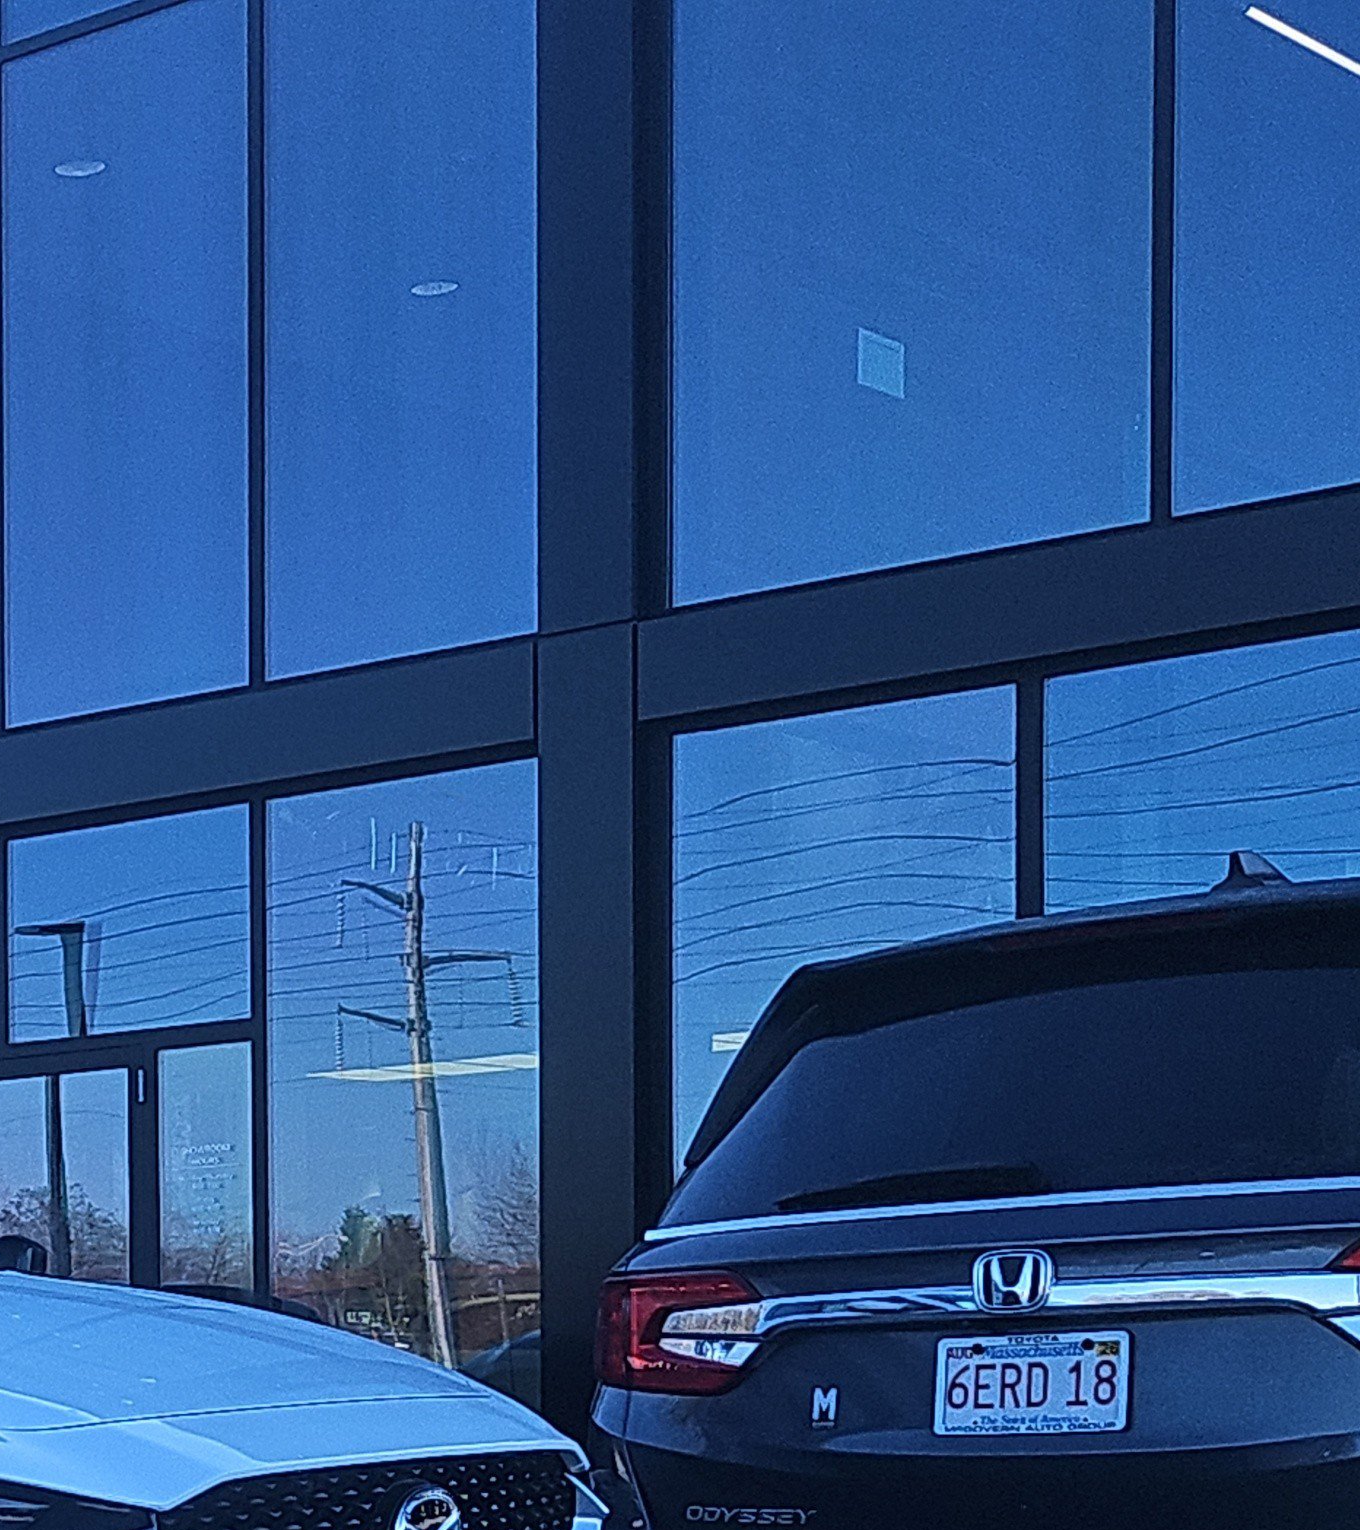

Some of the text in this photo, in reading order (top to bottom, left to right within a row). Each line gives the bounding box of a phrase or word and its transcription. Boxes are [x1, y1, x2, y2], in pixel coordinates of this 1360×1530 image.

[1006, 1334, 1060, 1345] TOYOTA
[982, 1341, 1085, 1360] Massachusetts
[947, 1359, 1117, 1410] 6ERD 18
[1025, 1423, 1063, 1432] AUTO
[686, 1505, 818, 1525] ODYSSEY
